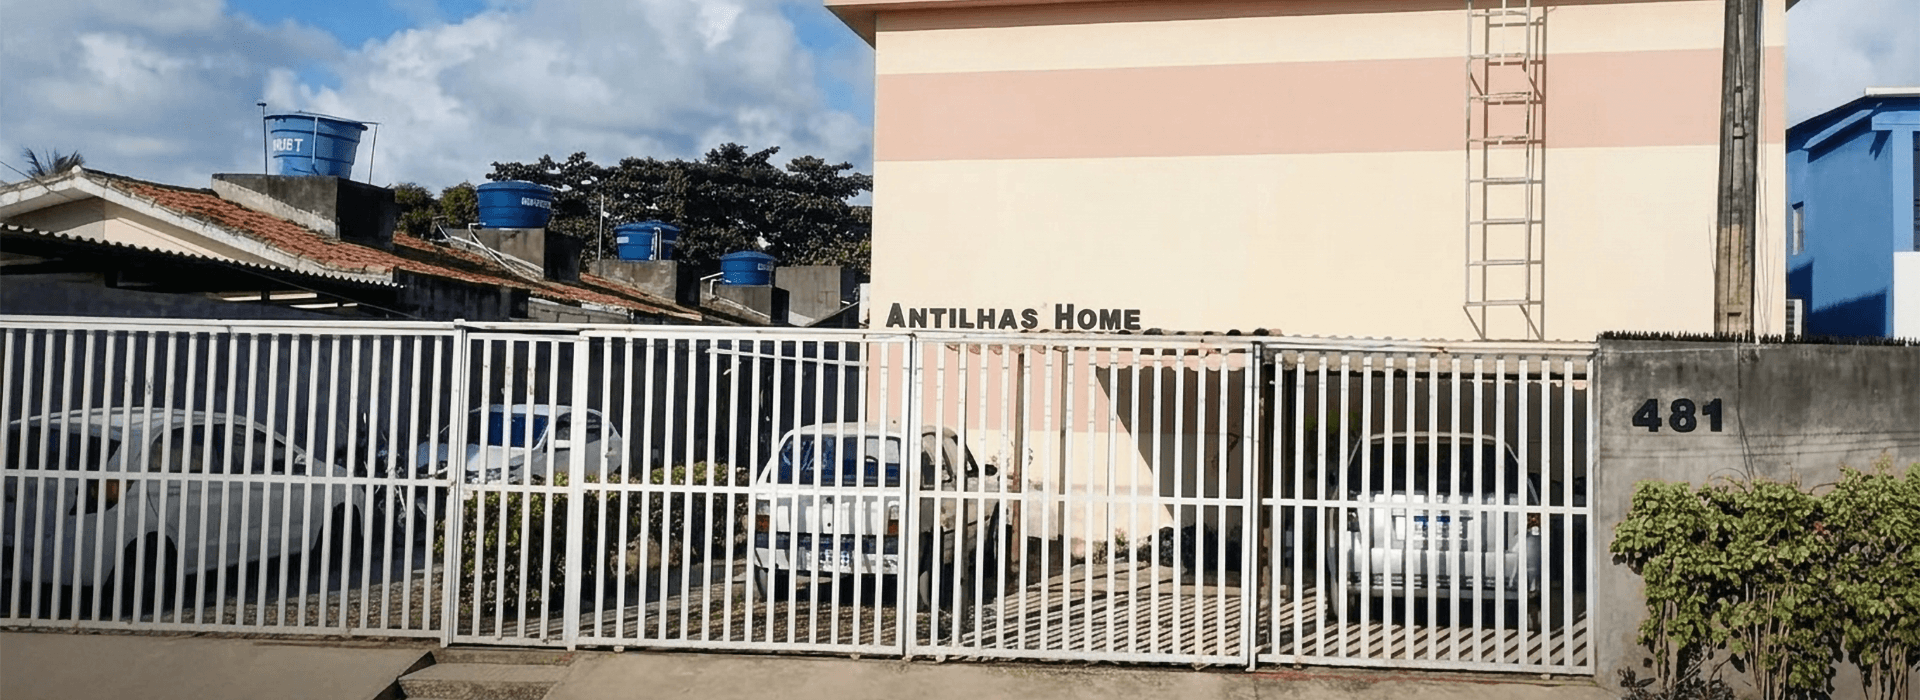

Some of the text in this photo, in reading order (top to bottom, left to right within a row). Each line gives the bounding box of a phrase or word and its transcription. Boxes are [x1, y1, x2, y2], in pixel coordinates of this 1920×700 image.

[885, 303, 1141, 330] ANTILHAS HOME
[1632, 398, 1722, 433] 481
